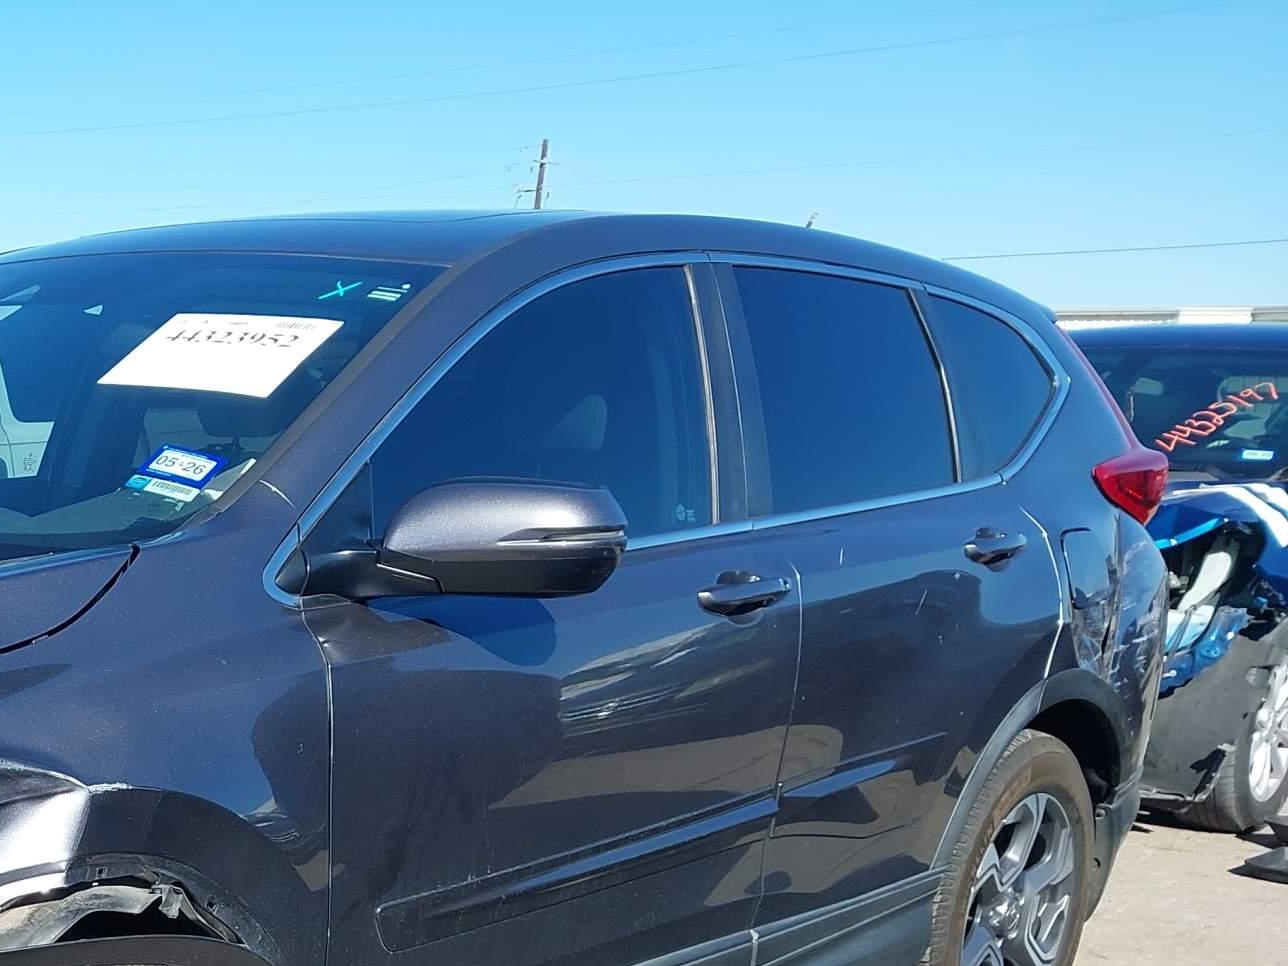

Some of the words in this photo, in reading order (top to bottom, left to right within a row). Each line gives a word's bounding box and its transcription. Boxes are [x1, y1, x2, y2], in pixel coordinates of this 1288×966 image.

[166, 330, 300, 348] 44323952
[155, 455, 179, 468] 05
[181, 461, 207, 475] 26
